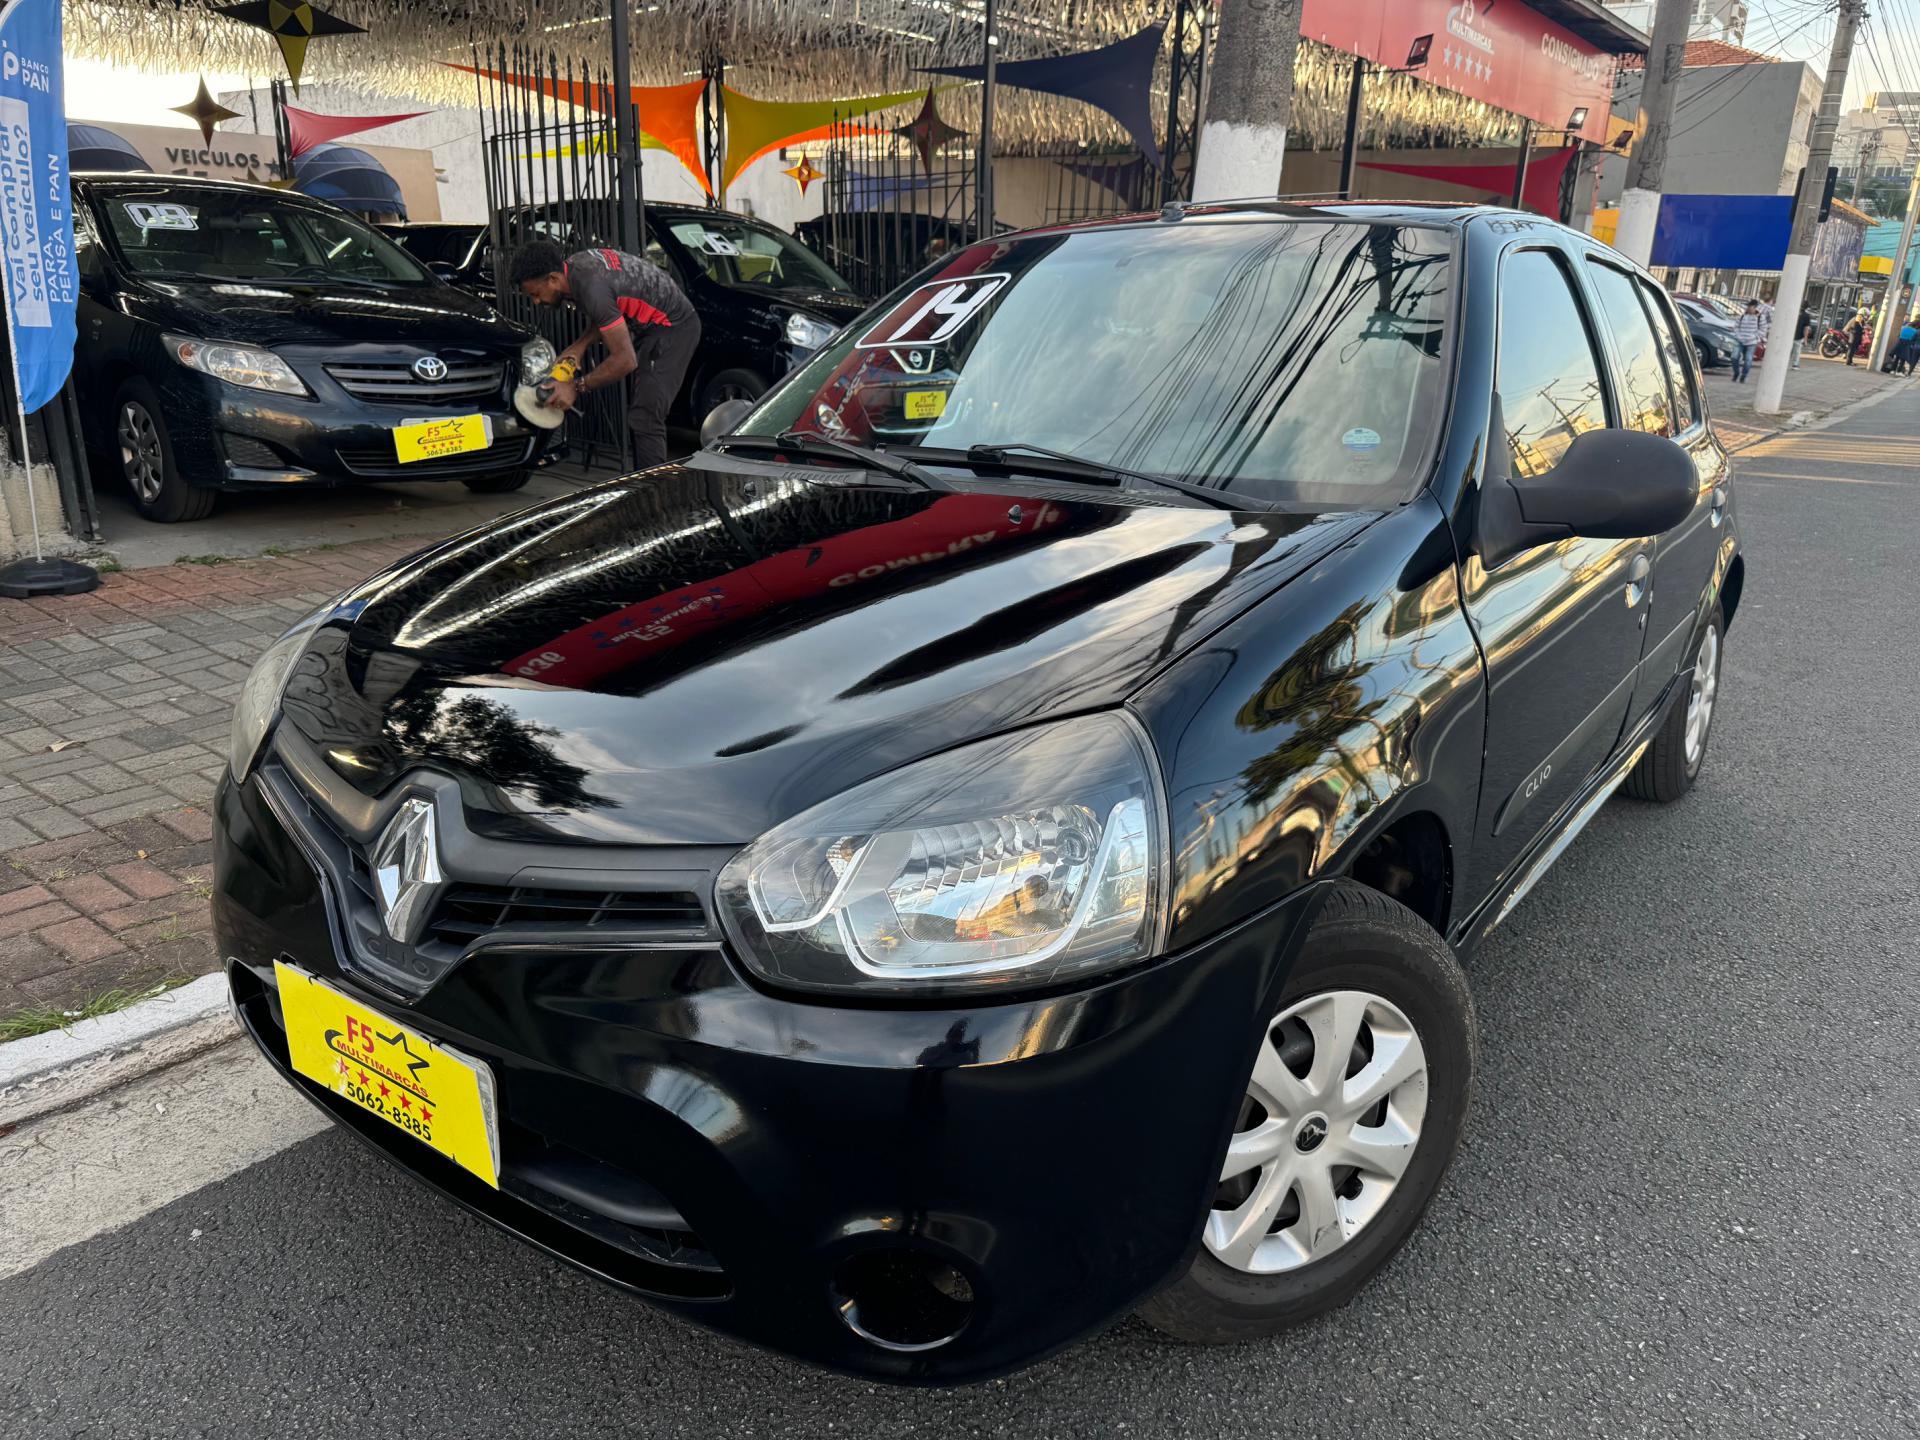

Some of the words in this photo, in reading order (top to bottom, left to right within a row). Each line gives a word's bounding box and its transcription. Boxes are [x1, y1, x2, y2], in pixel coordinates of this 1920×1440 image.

[1452, 18, 1492, 49] MULTIMARCAS
[1541, 33, 1599, 80] CONSIGNADO
[21, 57, 49, 74] BANCO
[22, 68, 49, 93] PAN
[48, 153, 61, 202] PAN
[165, 147, 260, 168] VEICULOS
[0, 120, 20, 250] comprar
[14, 124, 36, 245] veículo?
[51, 207, 62, 221] E
[126, 203, 195, 229] 09
[10, 257, 27, 302] Vai
[28, 251, 43, 302] seu
[43, 236, 61, 303] PARA,
[53, 227, 73, 303] PENSA
[886, 279, 1002, 343] 14
[427, 426, 440, 437] F5
[1525, 764, 1551, 798] CLIO
[345, 1014, 375, 1053] F5
[336, 1039, 429, 1098] MULTIMARCAS
[346, 1081, 432, 1141] 5062-8385
